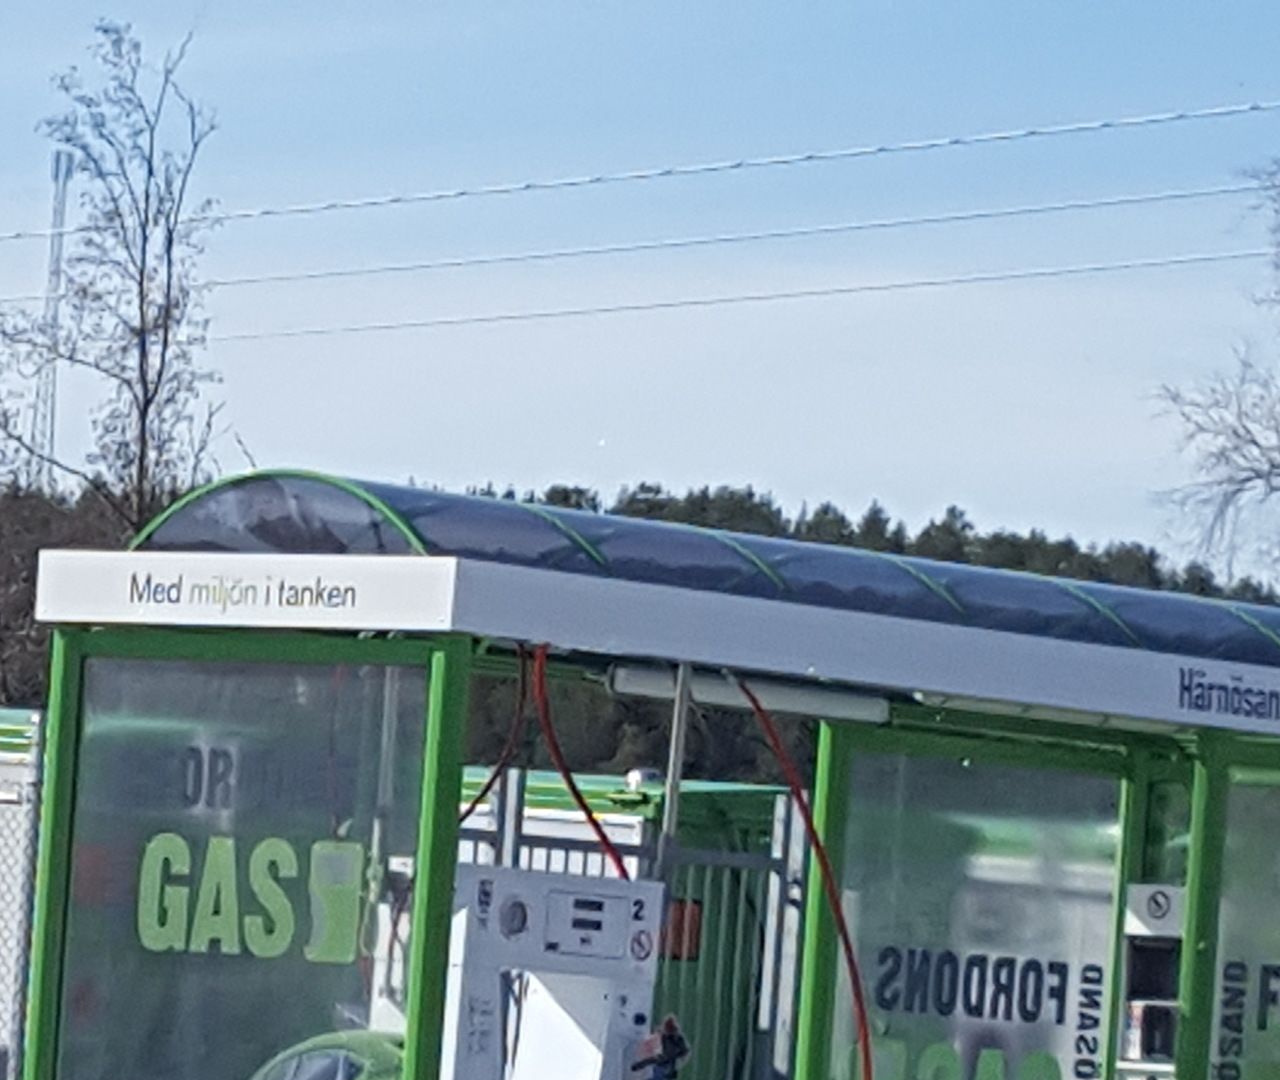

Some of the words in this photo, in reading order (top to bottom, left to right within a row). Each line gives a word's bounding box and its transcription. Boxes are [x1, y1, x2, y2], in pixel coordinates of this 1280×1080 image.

[129, 572, 183, 604] Med
[188, 575, 258, 615] miljön
[263, 576, 273, 607] i
[278, 575, 357, 609] tanken
[137, 832, 299, 958] GAS
[631, 899, 646, 922] 2
